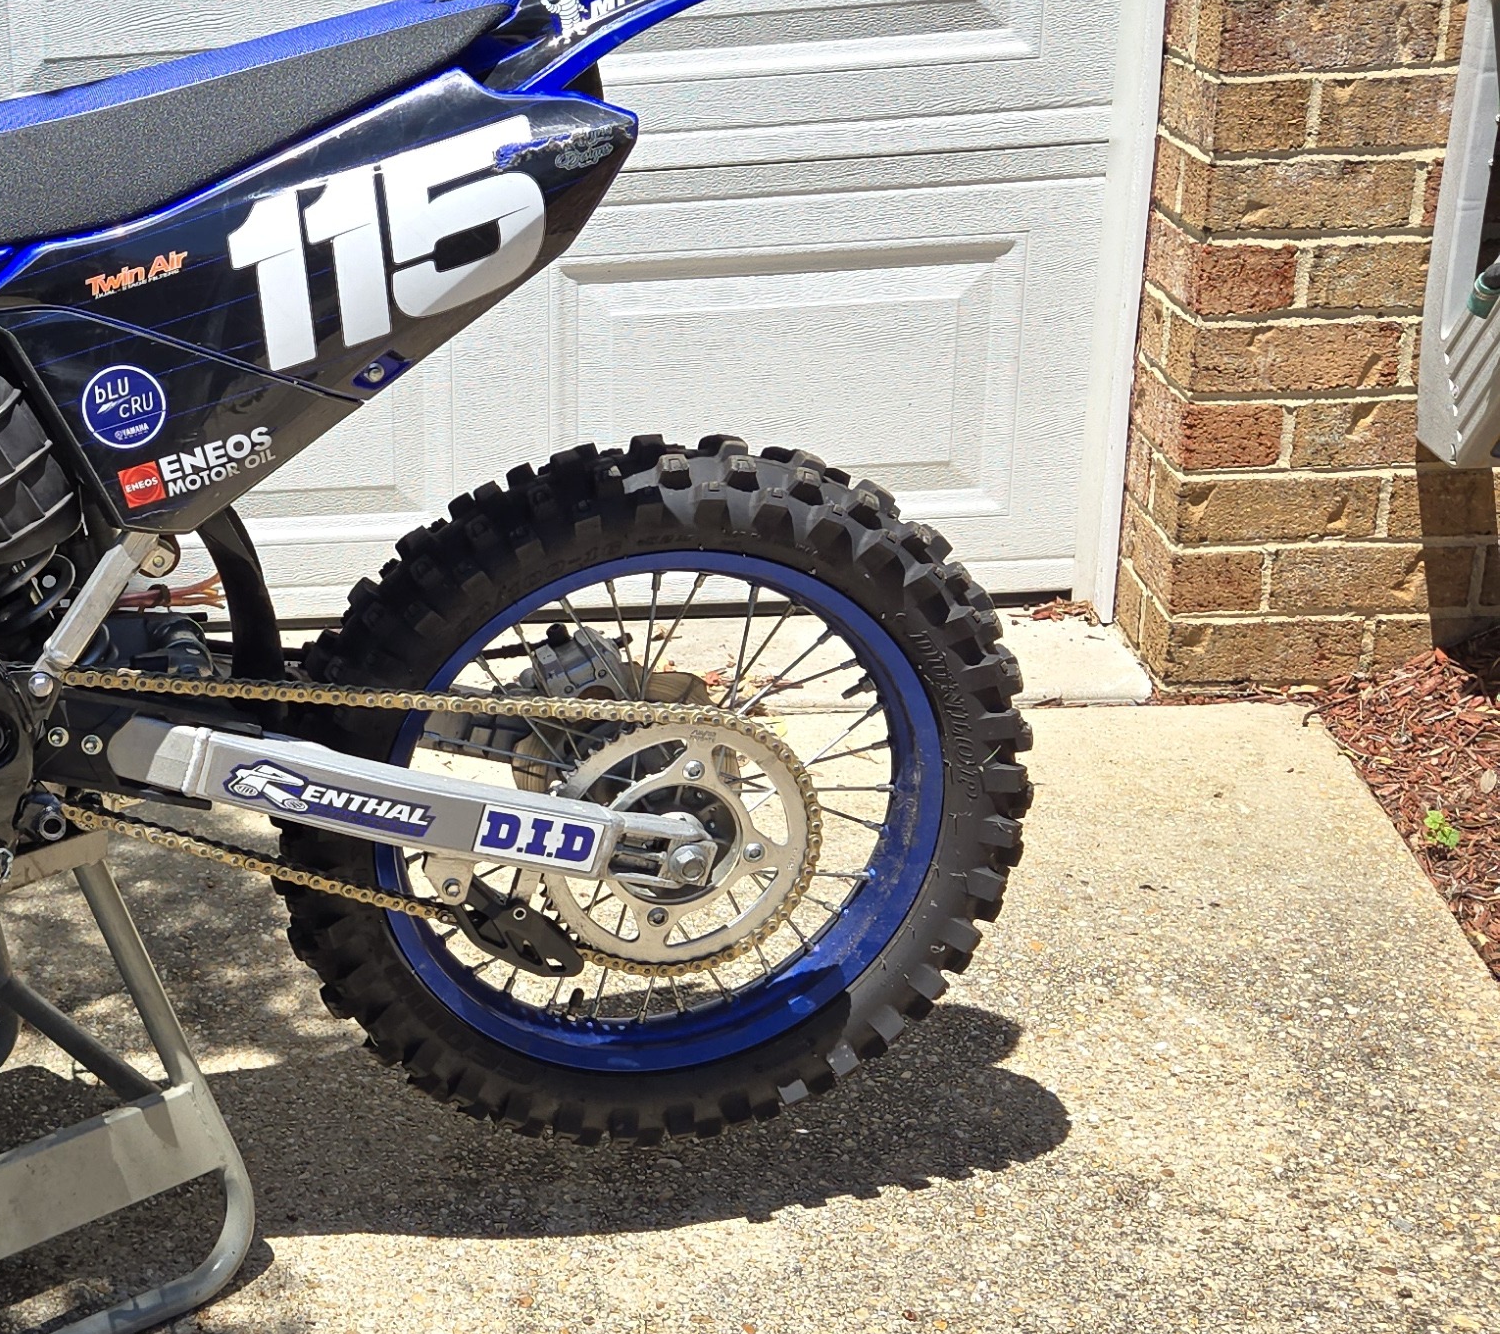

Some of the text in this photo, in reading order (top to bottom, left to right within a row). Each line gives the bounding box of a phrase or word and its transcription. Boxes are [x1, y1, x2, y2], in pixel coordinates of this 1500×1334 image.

[226, 114, 547, 372] 115
[84, 250, 188, 296] Twin Air
[158, 426, 273, 482] ENEOS
[167, 449, 277, 497] MOTOR OIL
[124, 476, 159, 493] ENEOS
[479, 810, 596, 863] D.I.D
